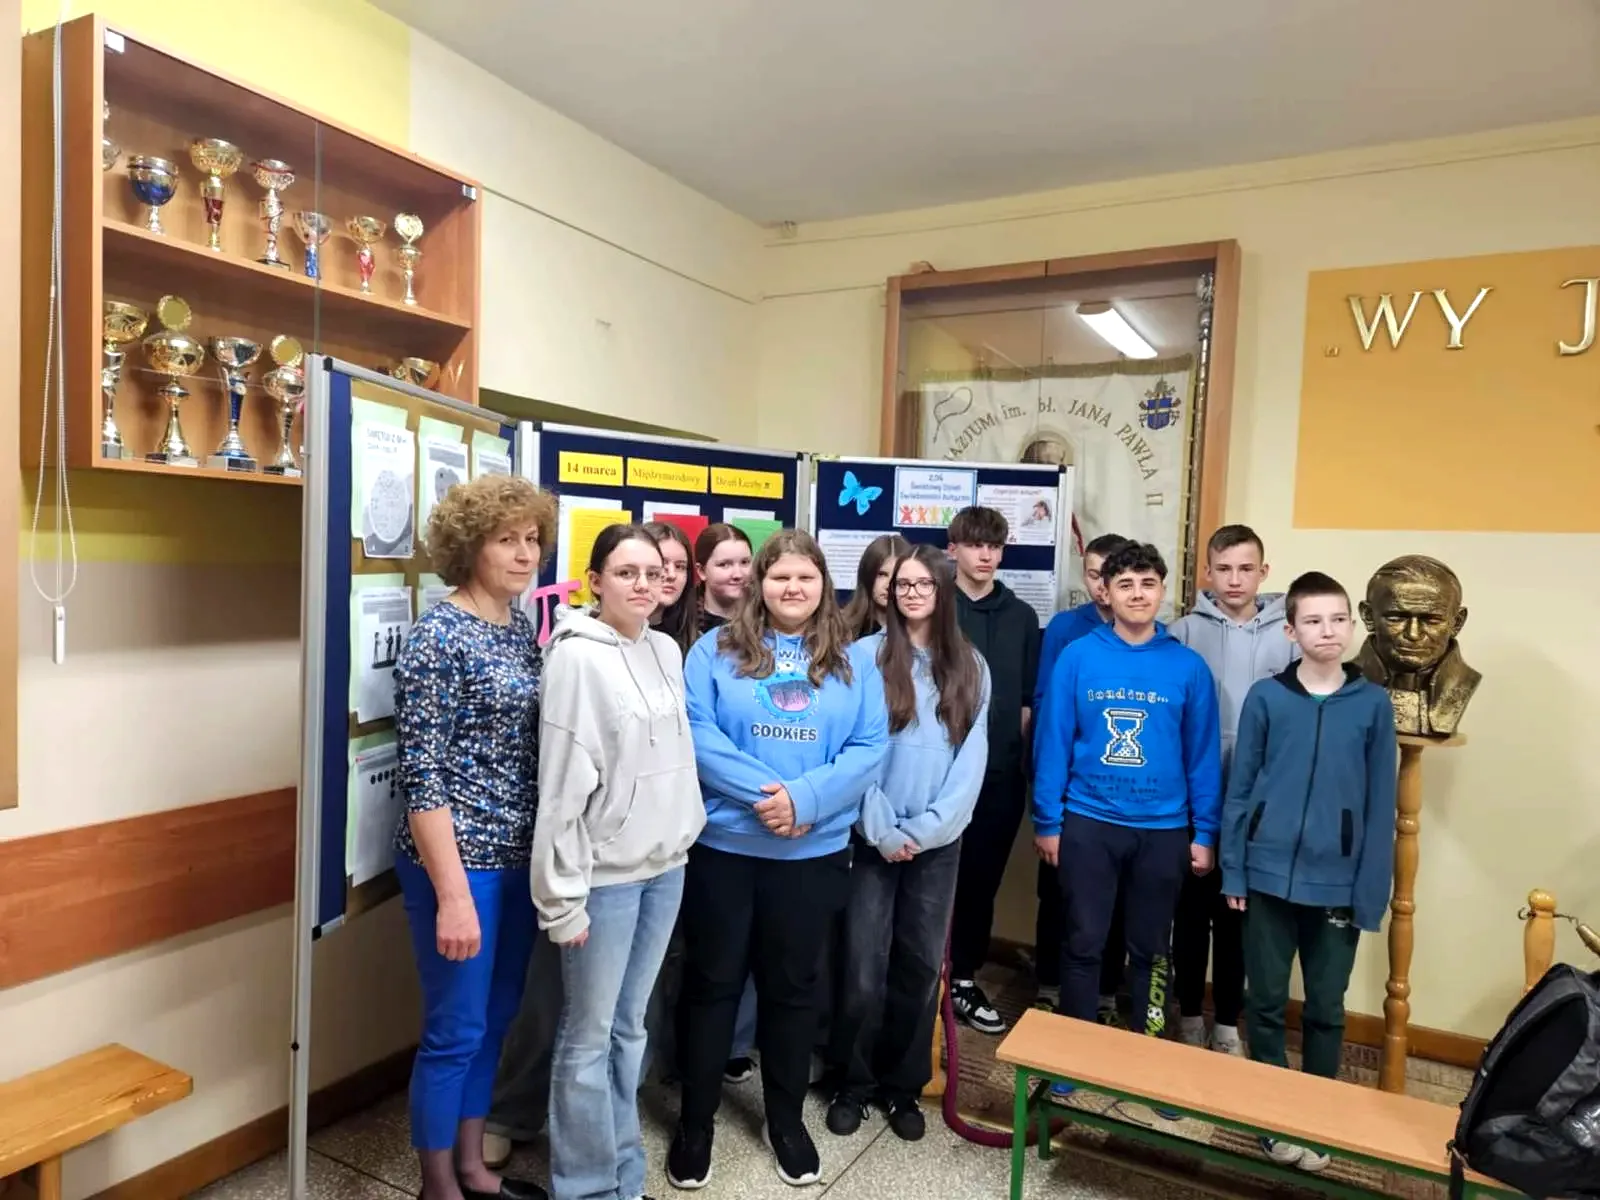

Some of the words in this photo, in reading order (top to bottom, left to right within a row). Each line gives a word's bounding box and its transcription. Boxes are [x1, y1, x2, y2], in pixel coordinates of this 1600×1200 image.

[1067, 399, 1112, 428] JANA
[567, 462, 579, 473] 14
[582, 464, 617, 476] marca
[1087, 687, 1169, 704] loading...
